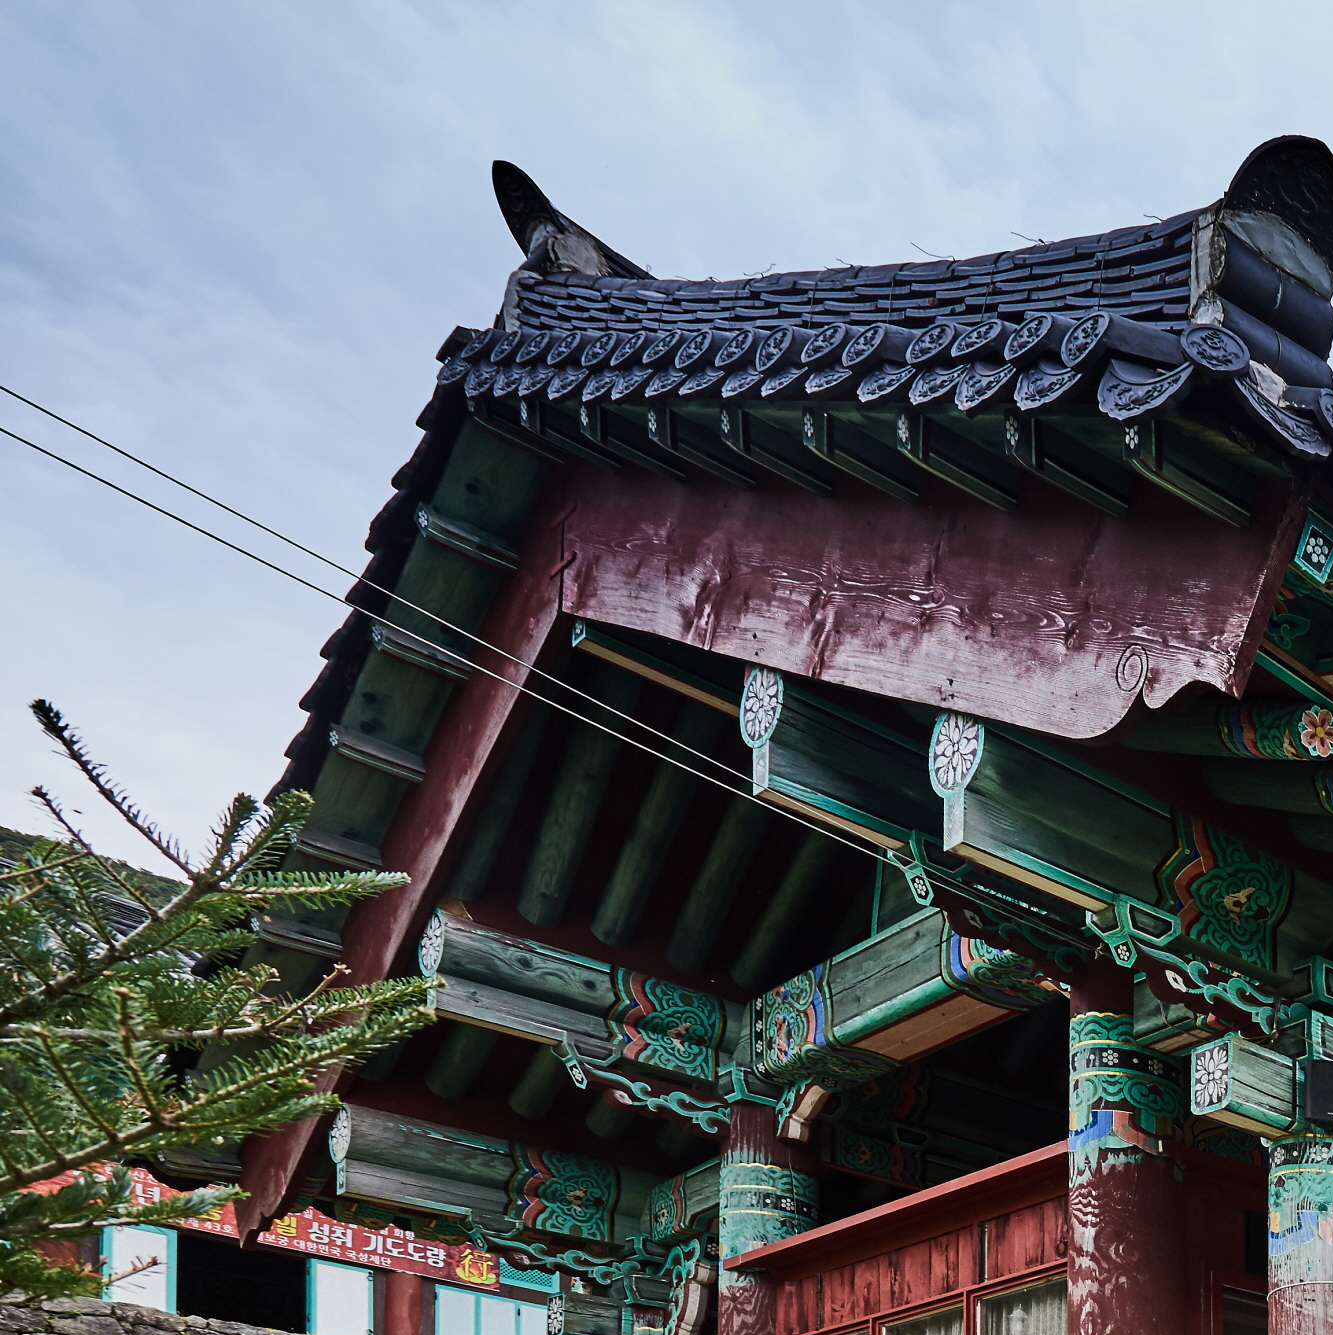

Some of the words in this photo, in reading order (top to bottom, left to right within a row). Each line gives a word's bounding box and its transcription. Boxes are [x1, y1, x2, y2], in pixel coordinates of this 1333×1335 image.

[203, 1221, 234, 1235] 43호
[272, 1216, 297, 1237] 일
[307, 1221, 353, 1248] 성취
[363, 1232, 446, 1268] 기도도량
[257, 1232, 289, 1246] 보궁
[293, 1239, 341, 1257] 대한민국
[346, 1249, 392, 1267] 국성제단
[460, 1247, 495, 1281] 行
